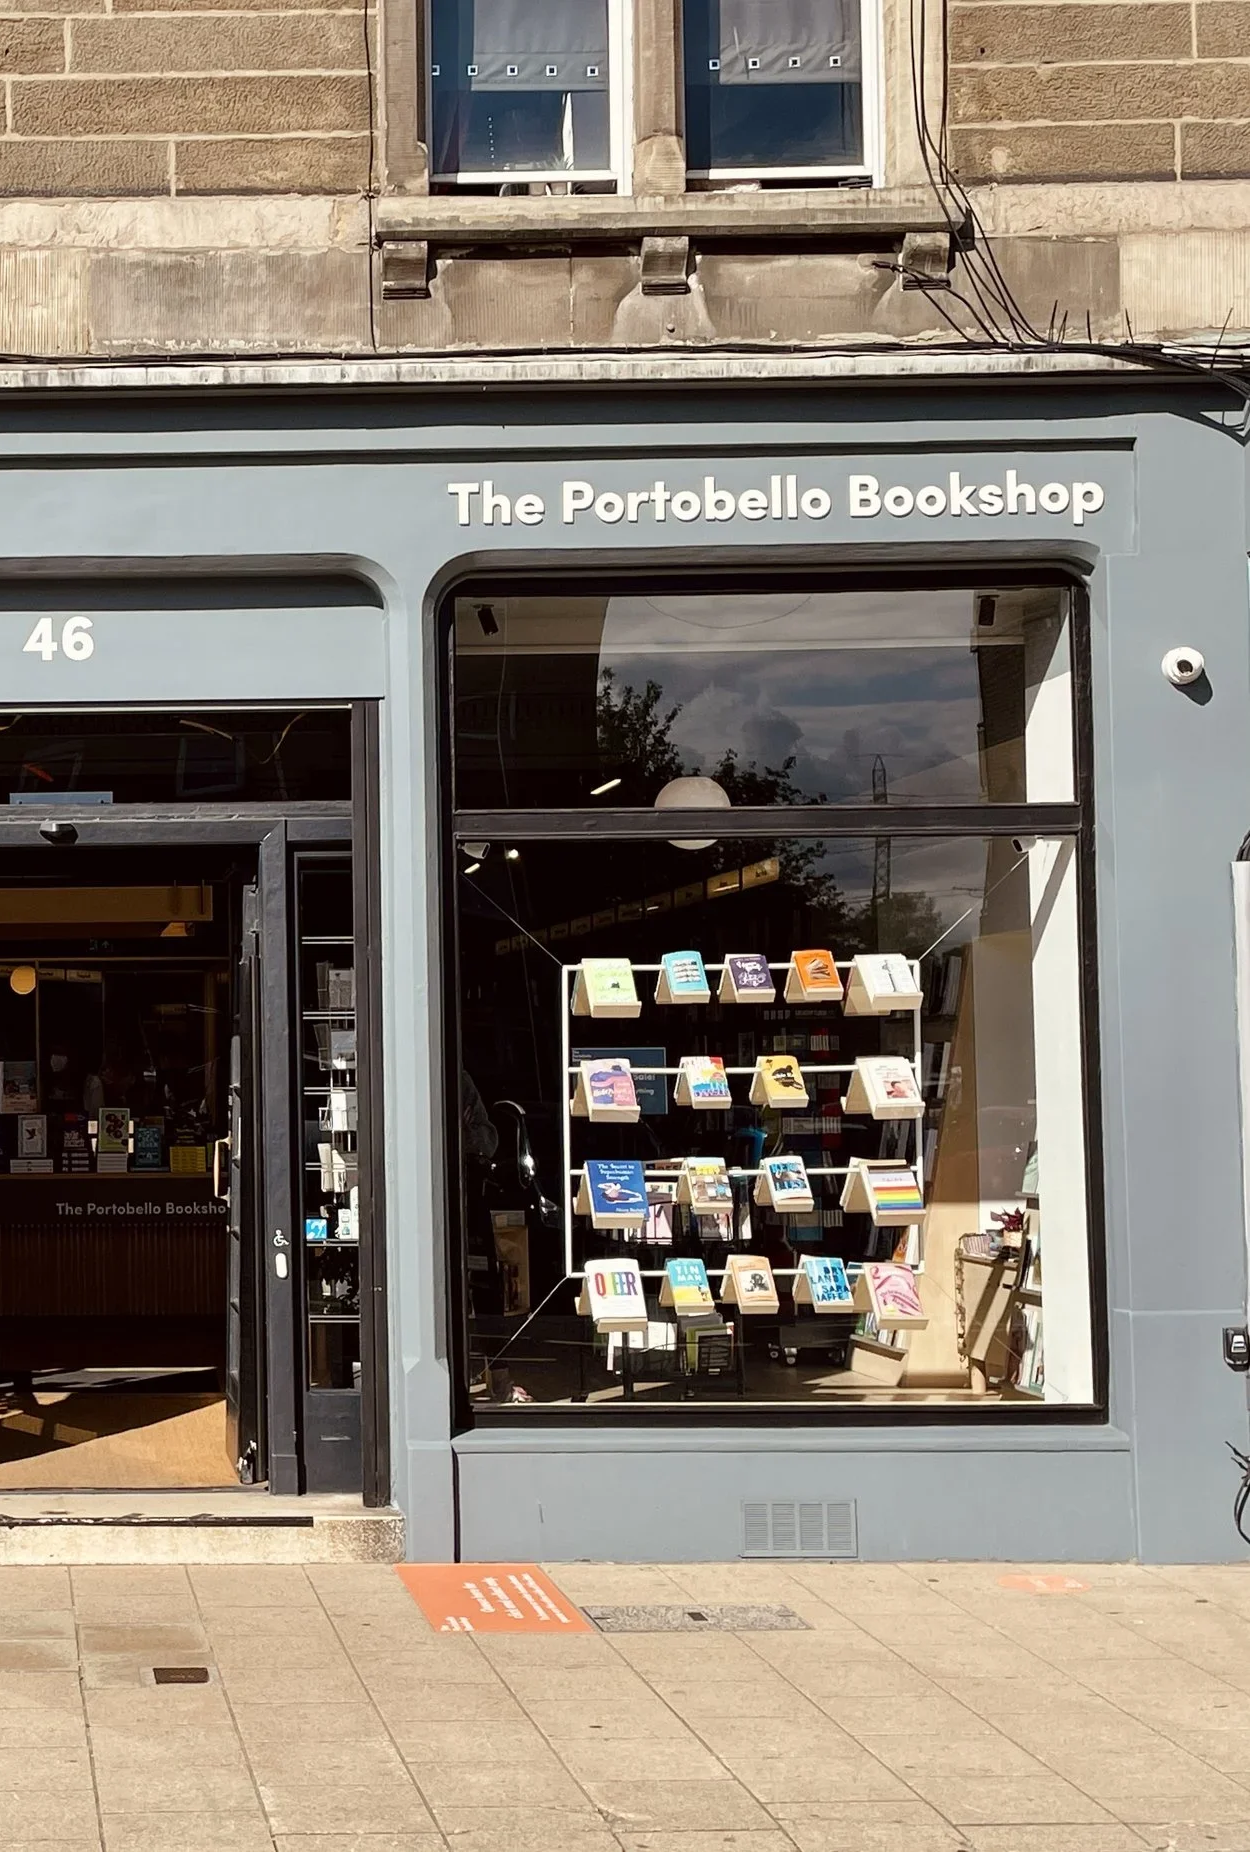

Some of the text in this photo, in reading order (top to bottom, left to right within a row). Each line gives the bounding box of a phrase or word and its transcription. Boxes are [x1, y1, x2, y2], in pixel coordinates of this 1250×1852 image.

[447, 469, 1105, 526] The Portobello Bookshop
[22, 616, 95, 661] 46
[56, 1201, 227, 1215] The Portobello Booksho
[675, 1264, 699, 1274] TIN
[676, 1274, 702, 1283] MAN
[594, 1271, 638, 1297] QUEER
